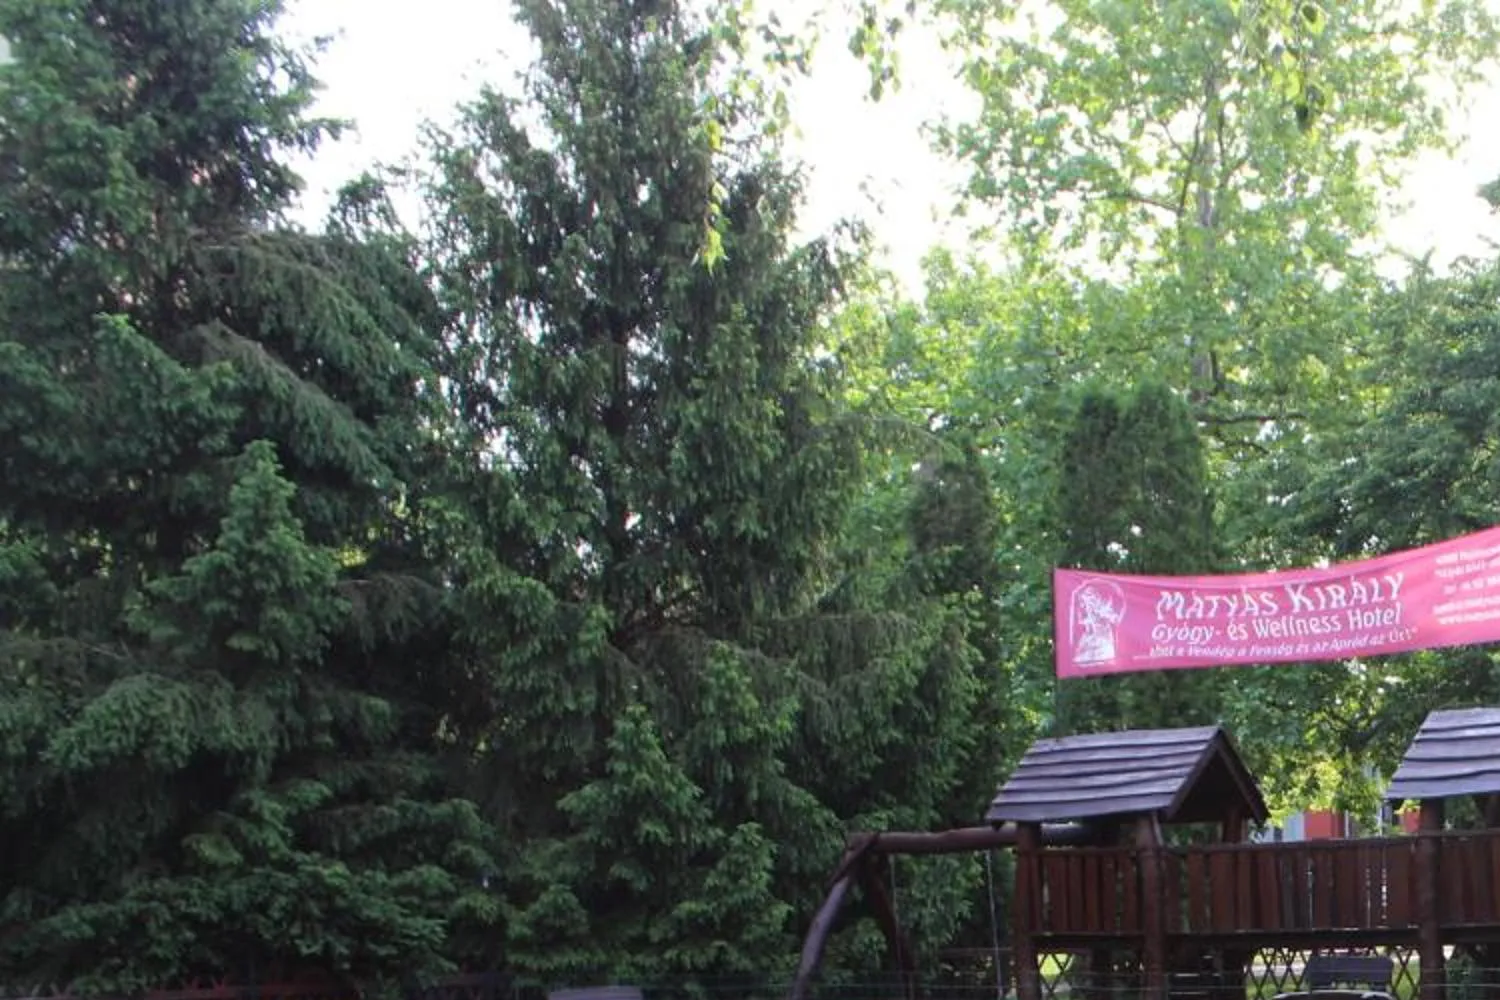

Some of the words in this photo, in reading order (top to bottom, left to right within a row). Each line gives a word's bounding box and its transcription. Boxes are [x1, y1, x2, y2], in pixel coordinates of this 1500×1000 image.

[1155, 585, 1279, 620] MÁTYÁS
[1284, 572, 1404, 613] KIRÁLY
[1226, 618, 1249, 640] és
[1251, 615, 1342, 639] Wellness
[1347, 601, 1401, 631] Hotel
